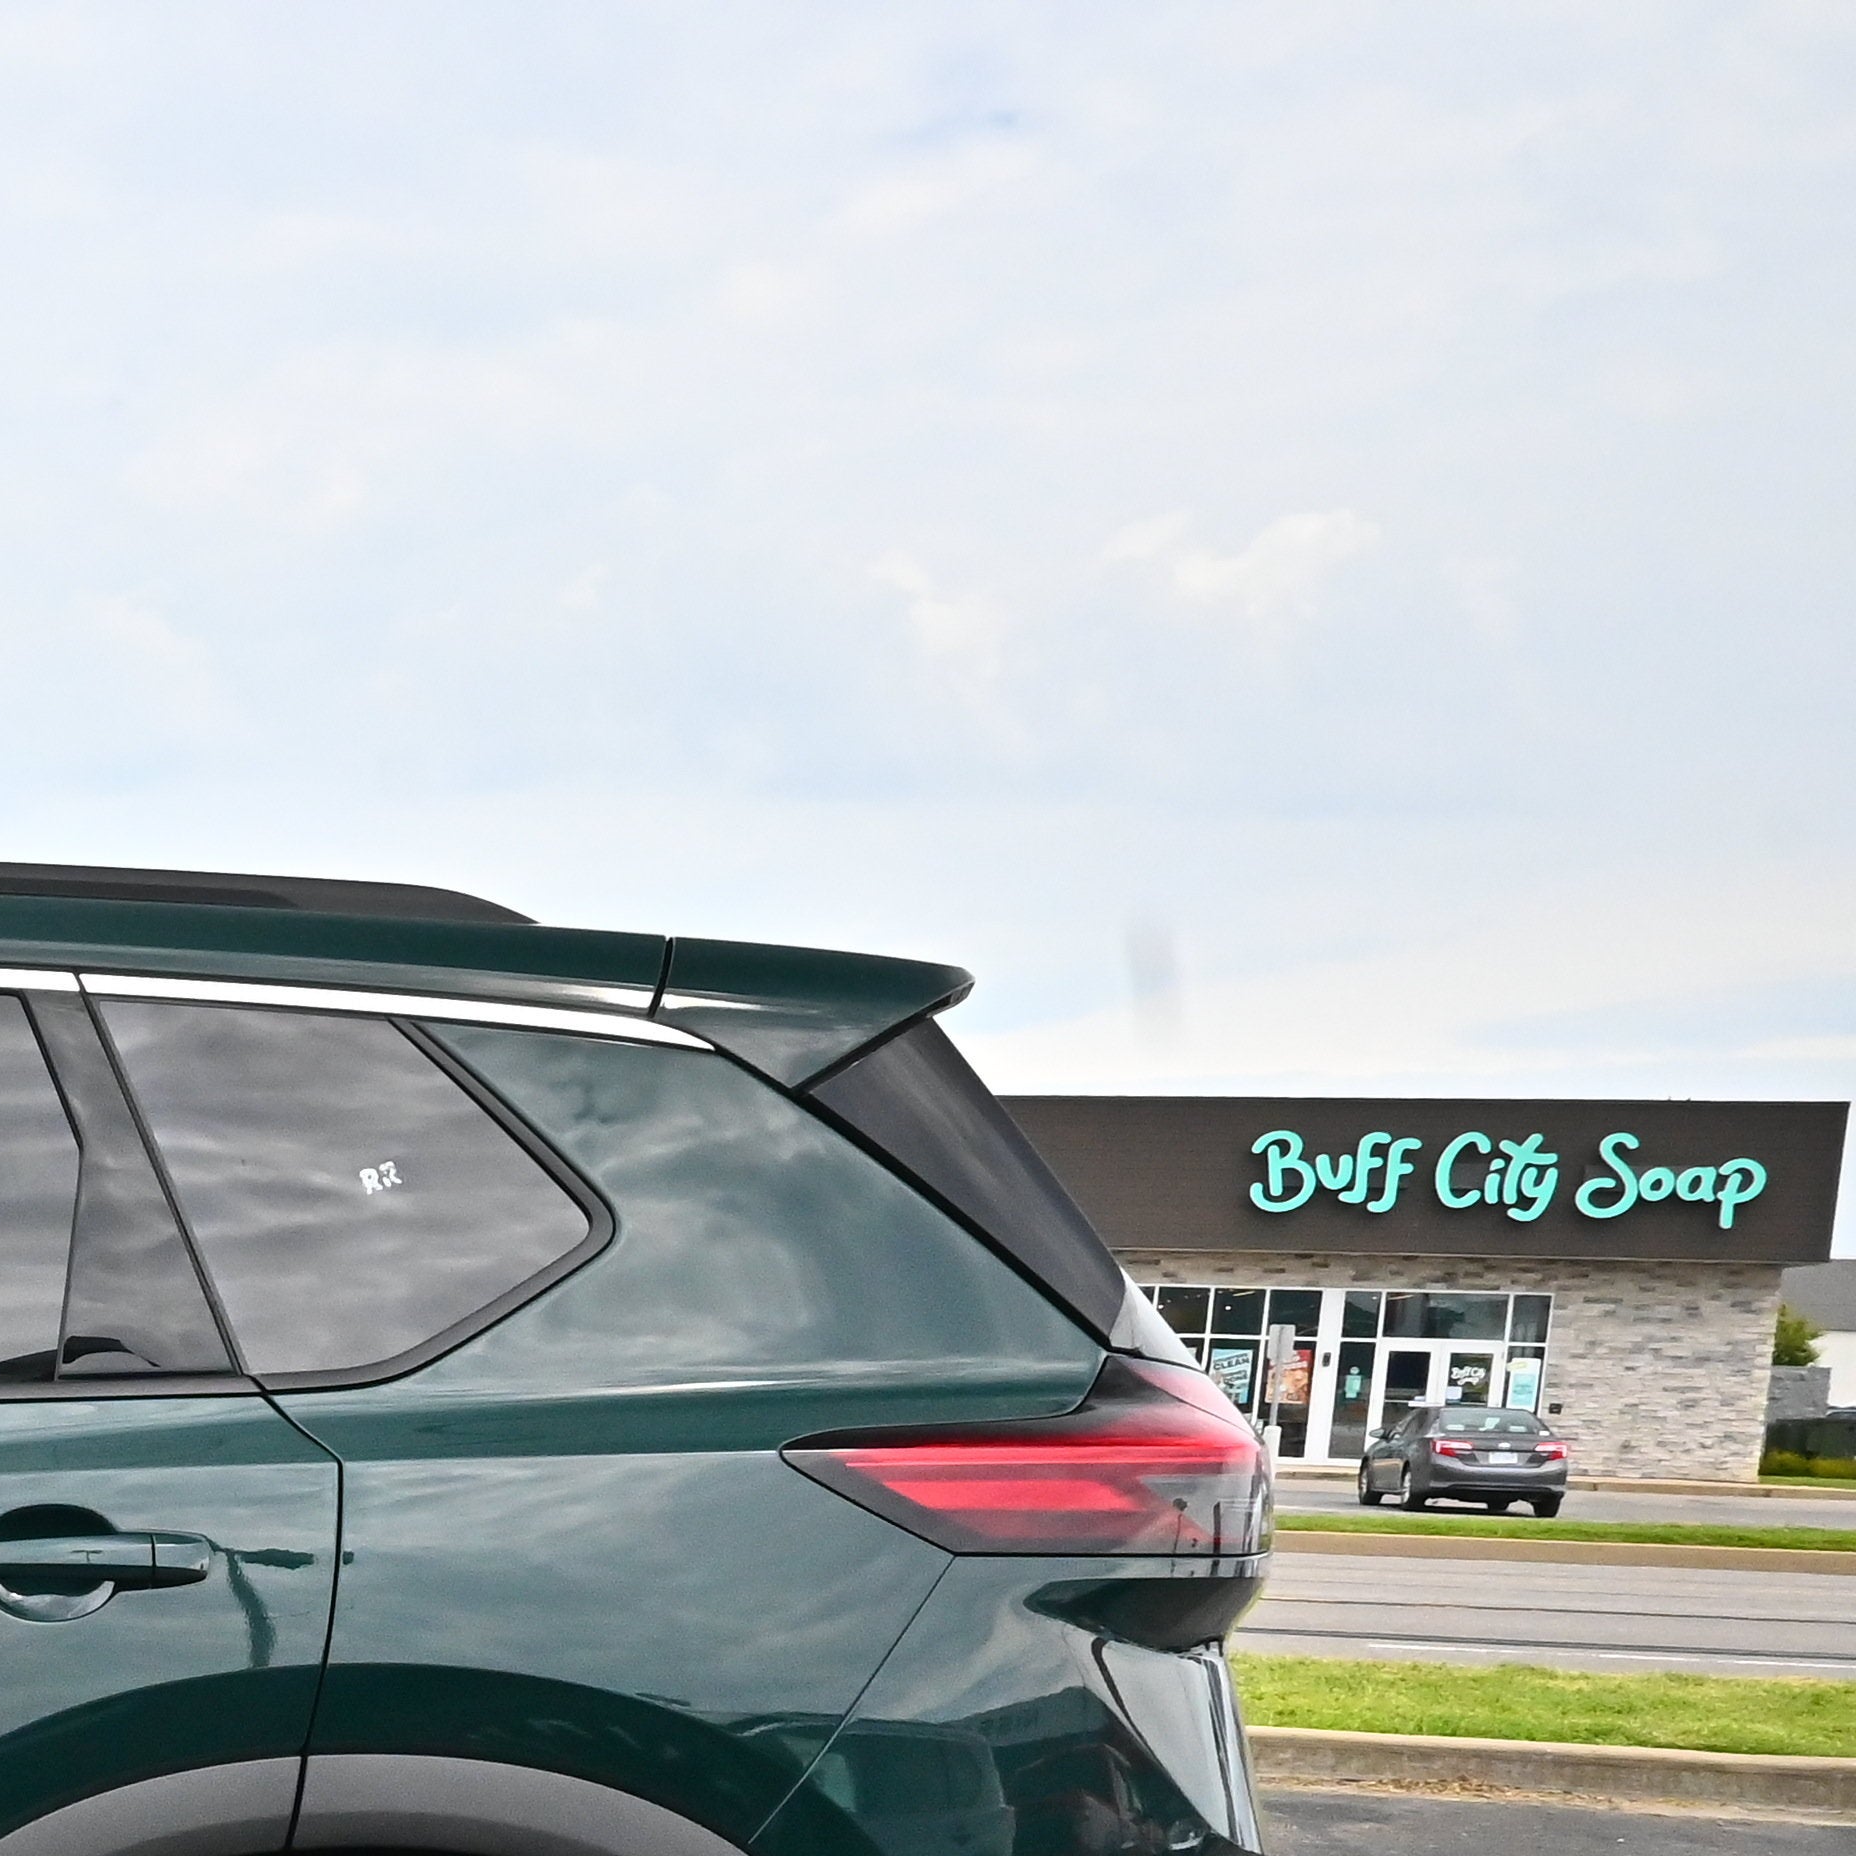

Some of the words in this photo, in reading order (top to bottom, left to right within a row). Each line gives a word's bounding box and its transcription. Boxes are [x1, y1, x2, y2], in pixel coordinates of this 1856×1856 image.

[1249, 1129, 1422, 1213] Buff
[1435, 1131, 1558, 1222] City
[1575, 1132, 1767, 1229] Soap
